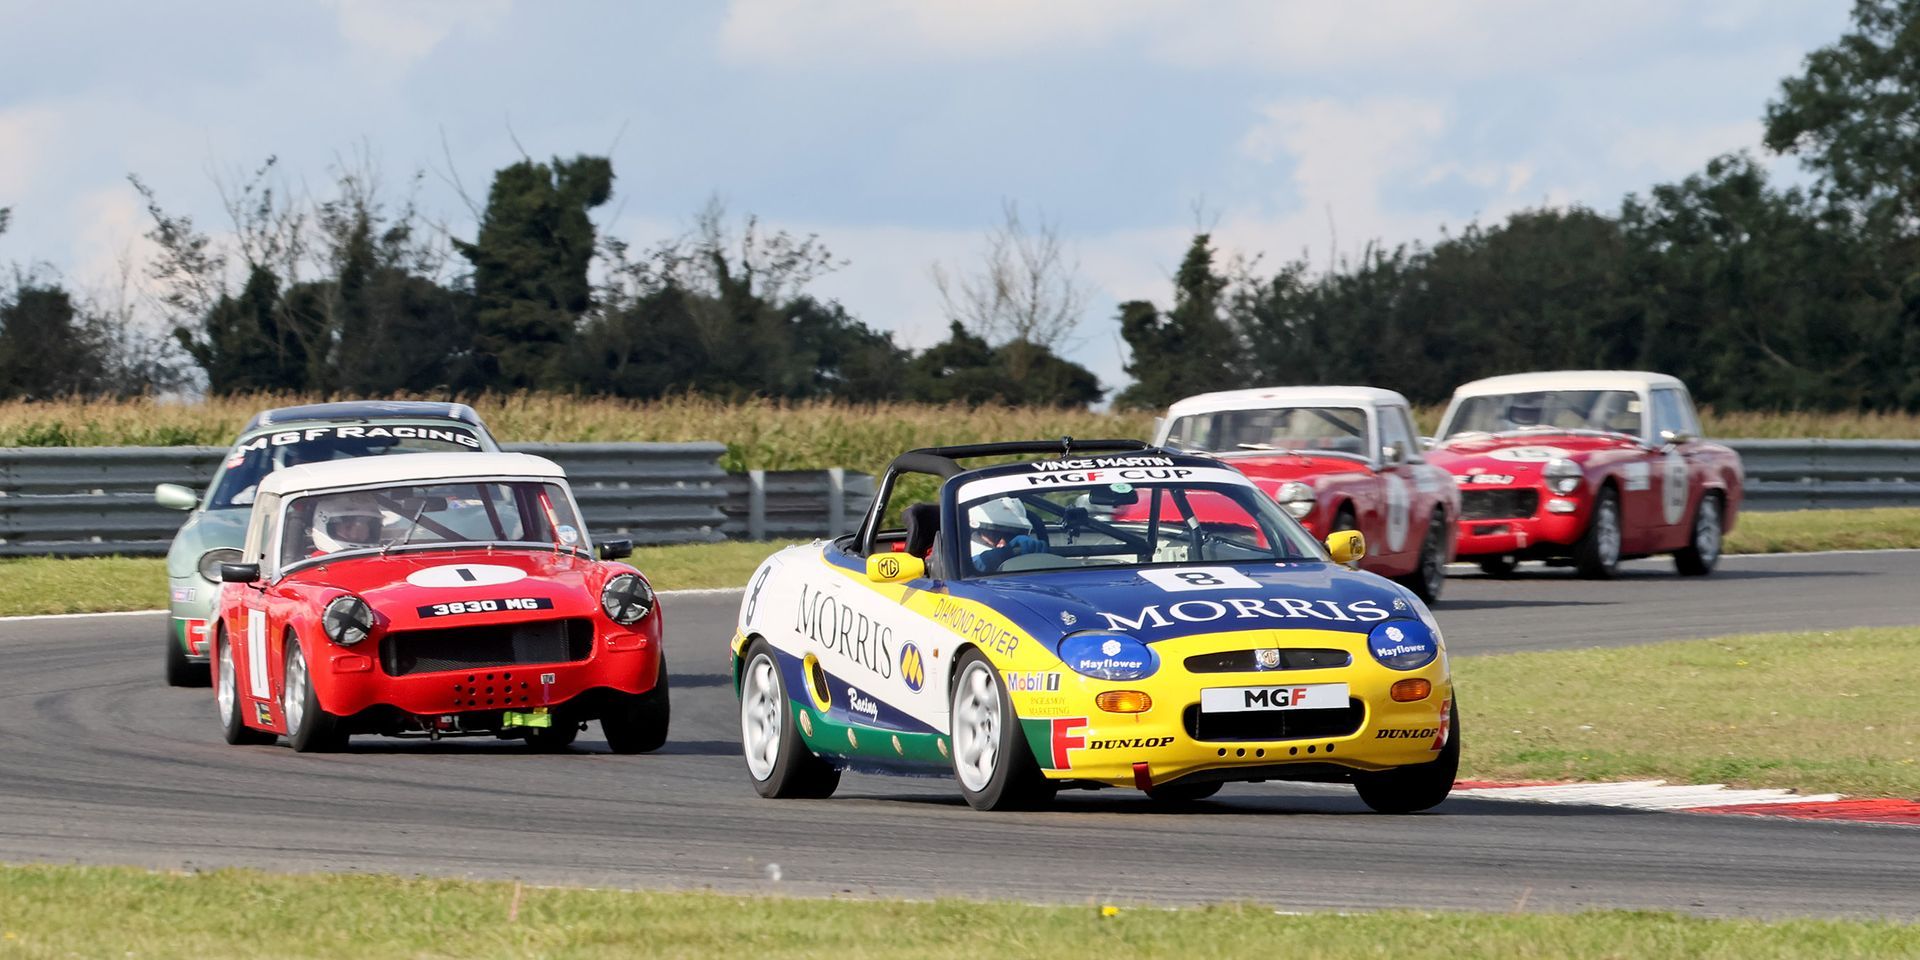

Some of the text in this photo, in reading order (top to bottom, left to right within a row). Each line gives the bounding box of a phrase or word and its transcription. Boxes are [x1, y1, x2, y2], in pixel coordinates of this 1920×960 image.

[234, 426, 480, 455] MGF RACING
[1031, 456, 1174, 472] VINCE MARTIN
[1027, 469, 1193, 485] MGF CUP
[456, 568, 477, 581] 1
[879, 558, 898, 578] MG
[1174, 571, 1224, 585] 8
[746, 565, 771, 627] 8
[432, 598, 538, 616] 3830 MG
[1096, 598, 1390, 631] MORRIS
[794, 583, 893, 680] MORRIS
[934, 598, 1019, 659] DIAMOND ROVER
[1376, 644, 1426, 658] Mayflower
[1080, 659, 1143, 670] Mayflower
[1007, 673, 1059, 691] Mobil 1
[847, 687, 879, 723] Racing
[1244, 688, 1307, 708] MGF
[1053, 717, 1087, 770] F
[1089, 736, 1175, 750] DUNLOP
